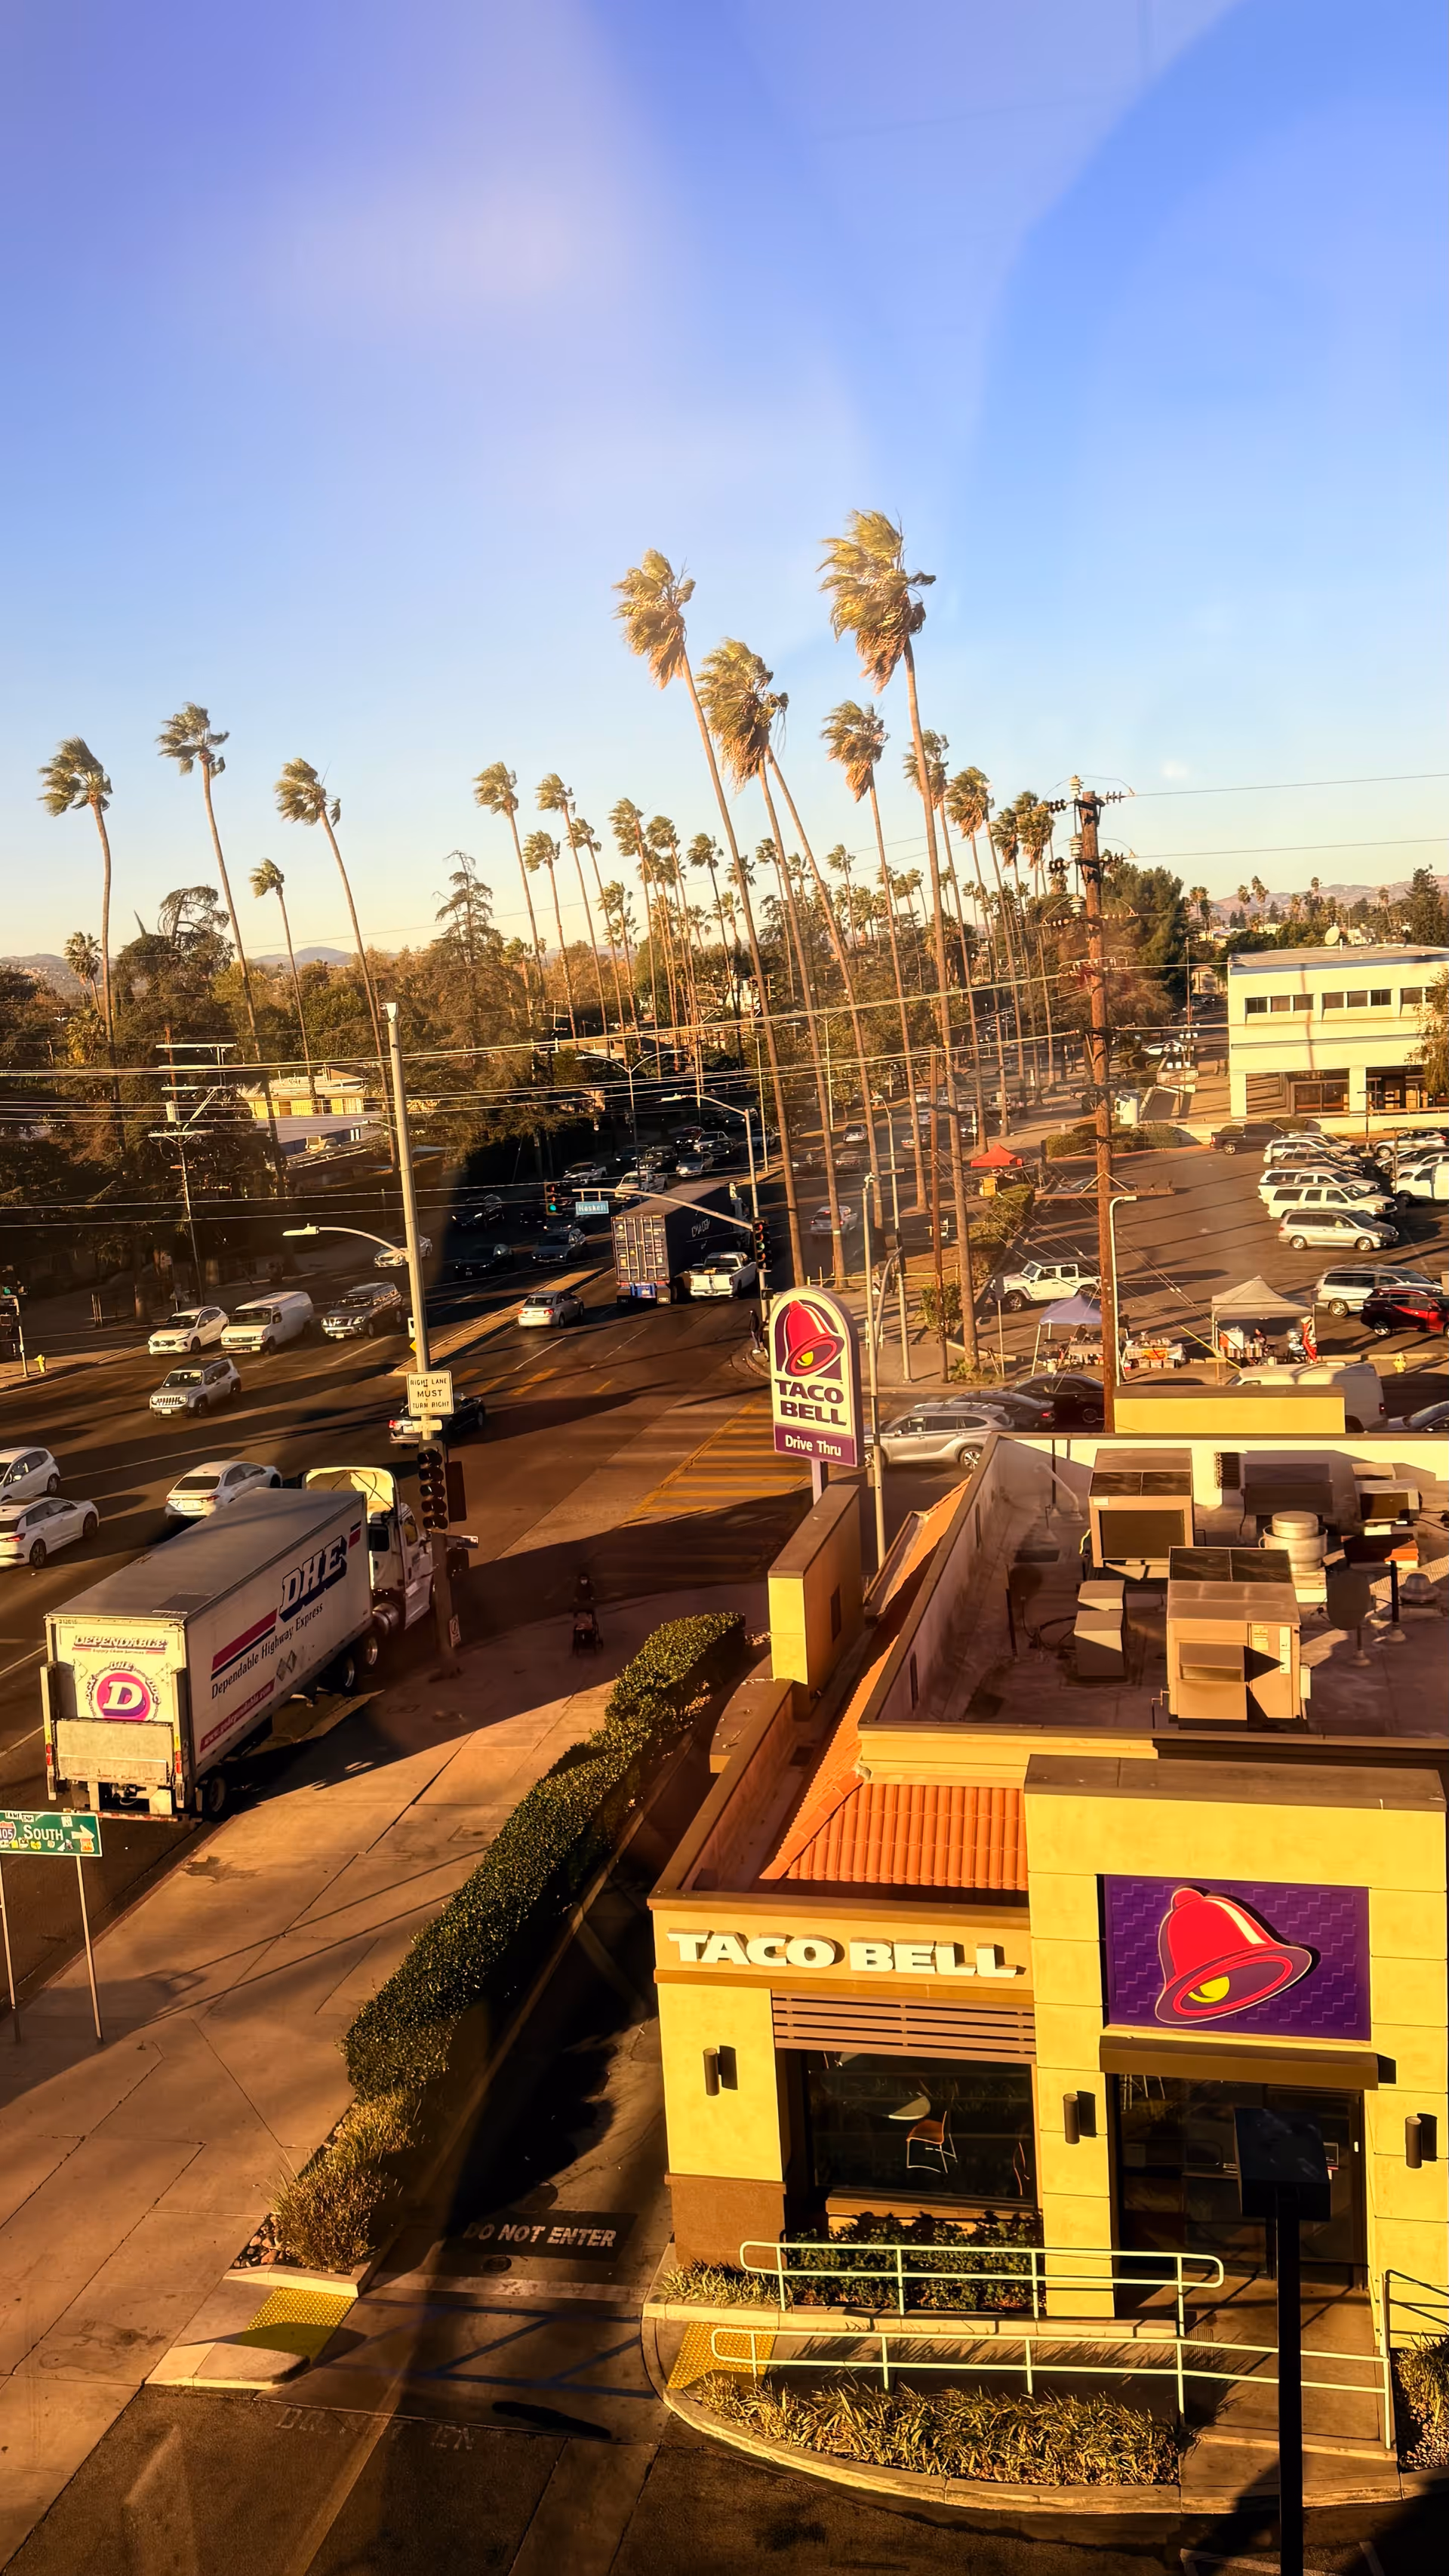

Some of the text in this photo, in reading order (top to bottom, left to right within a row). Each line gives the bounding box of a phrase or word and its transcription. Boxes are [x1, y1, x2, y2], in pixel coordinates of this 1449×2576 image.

[578, 1204, 607, 1212] Haskell
[417, 1389, 443, 1398] MUST
[774, 1378, 844, 1405] TACO
[780, 1399, 848, 1426] BELL
[785, 1434, 842, 1457] Drive Thru
[278, 1534, 347, 1623] DHE
[73, 1634, 168, 1651] DEPENDABLE
[211, 1602, 323, 1700] Dependable Highway Express
[103, 1681, 146, 1717] D
[23, 1824, 64, 1841] SOUTH
[667, 1928, 1019, 1978] TACO BELL
[463, 2222, 617, 2248] DO NOT ENTER
